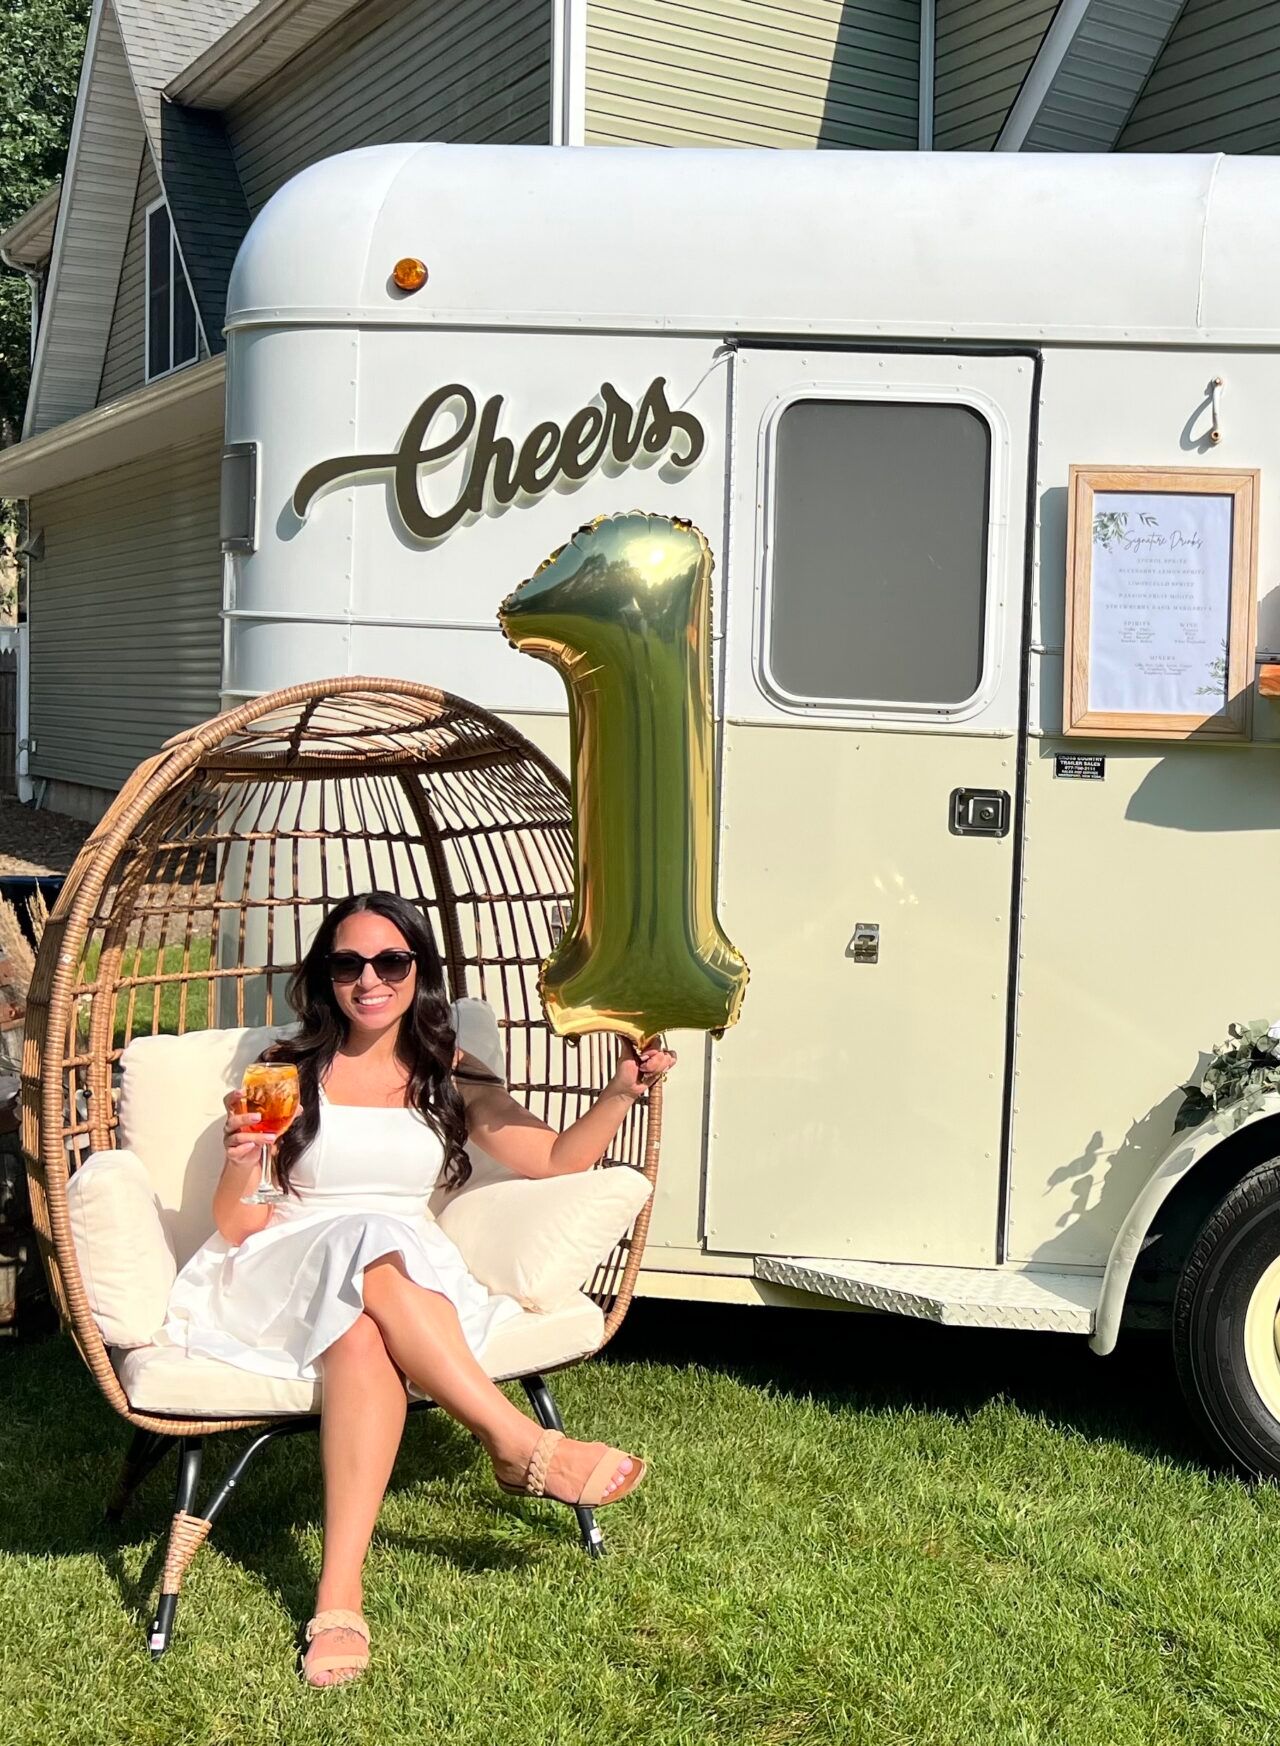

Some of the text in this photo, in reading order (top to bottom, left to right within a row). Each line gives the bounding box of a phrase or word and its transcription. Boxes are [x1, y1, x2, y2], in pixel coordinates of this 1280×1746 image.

[293, 376, 705, 540] Cheers
[1124, 530, 1203, 553] Signature Drinks
